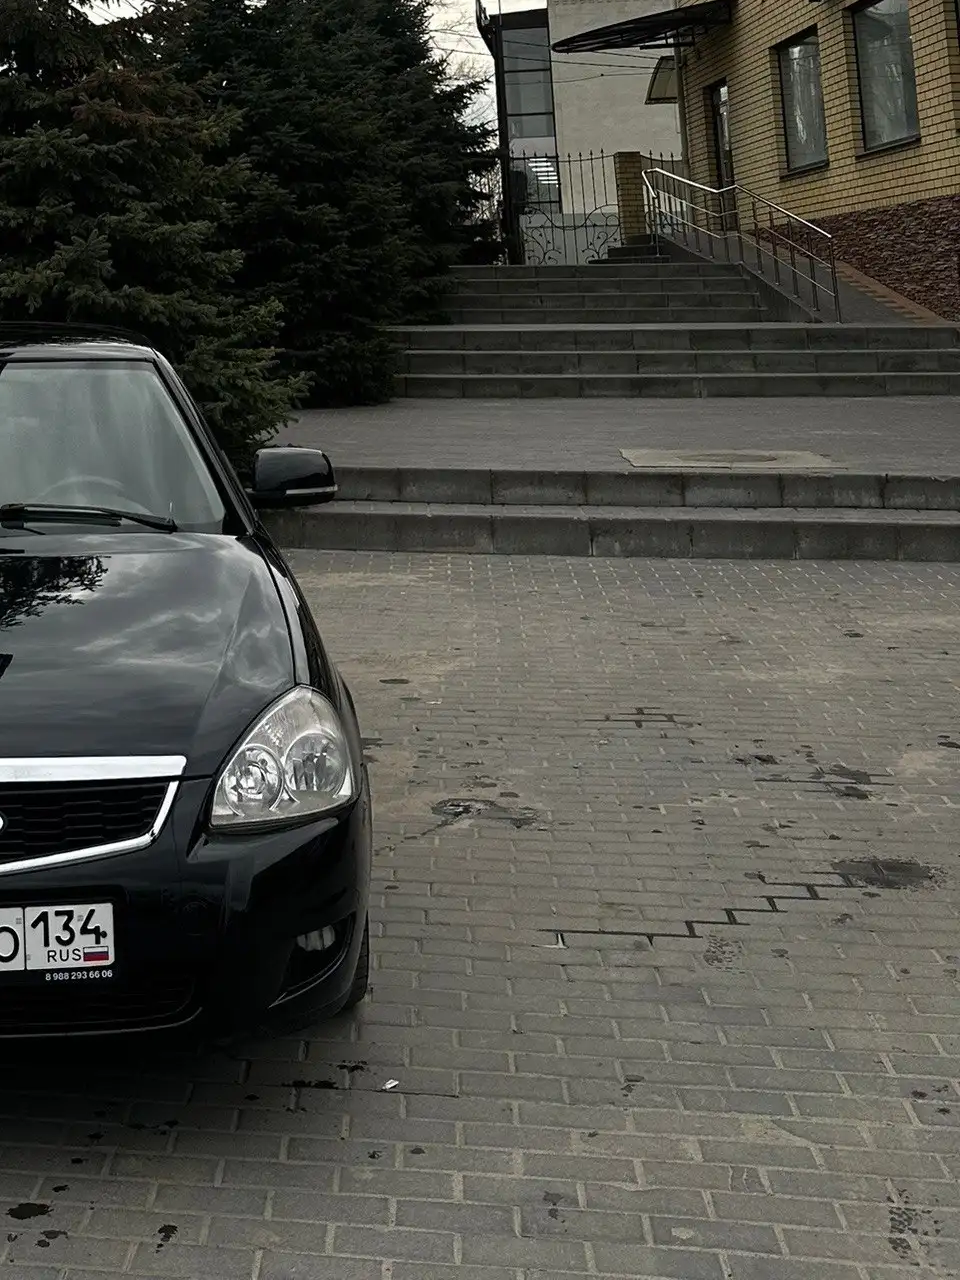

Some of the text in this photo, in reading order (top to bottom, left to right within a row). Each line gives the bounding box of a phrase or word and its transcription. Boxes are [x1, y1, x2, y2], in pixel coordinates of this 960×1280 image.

[30, 908, 102, 948] 134
[46, 947, 82, 963] RUS
[45, 969, 113, 981] 8 988 293 66 06
